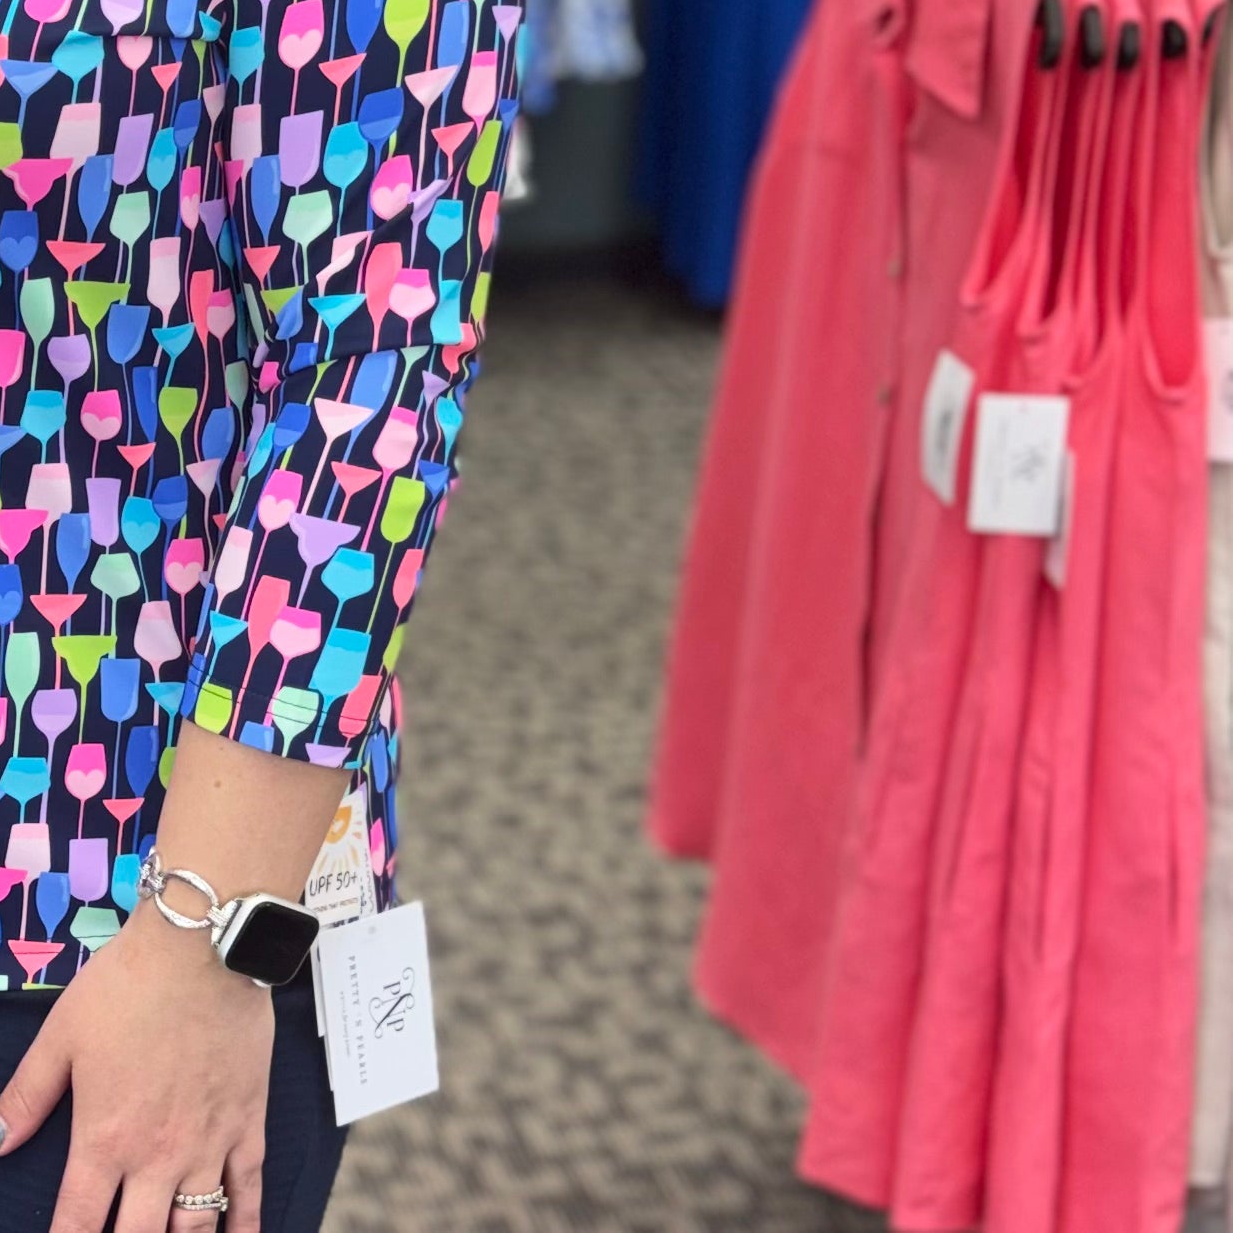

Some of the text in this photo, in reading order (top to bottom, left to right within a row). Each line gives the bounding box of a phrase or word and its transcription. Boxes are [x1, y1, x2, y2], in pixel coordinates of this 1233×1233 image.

[309, 870, 358, 897] UPF 50+
[348, 955, 360, 1006] PRETTY
[356, 1035, 367, 1085] PEARLS
